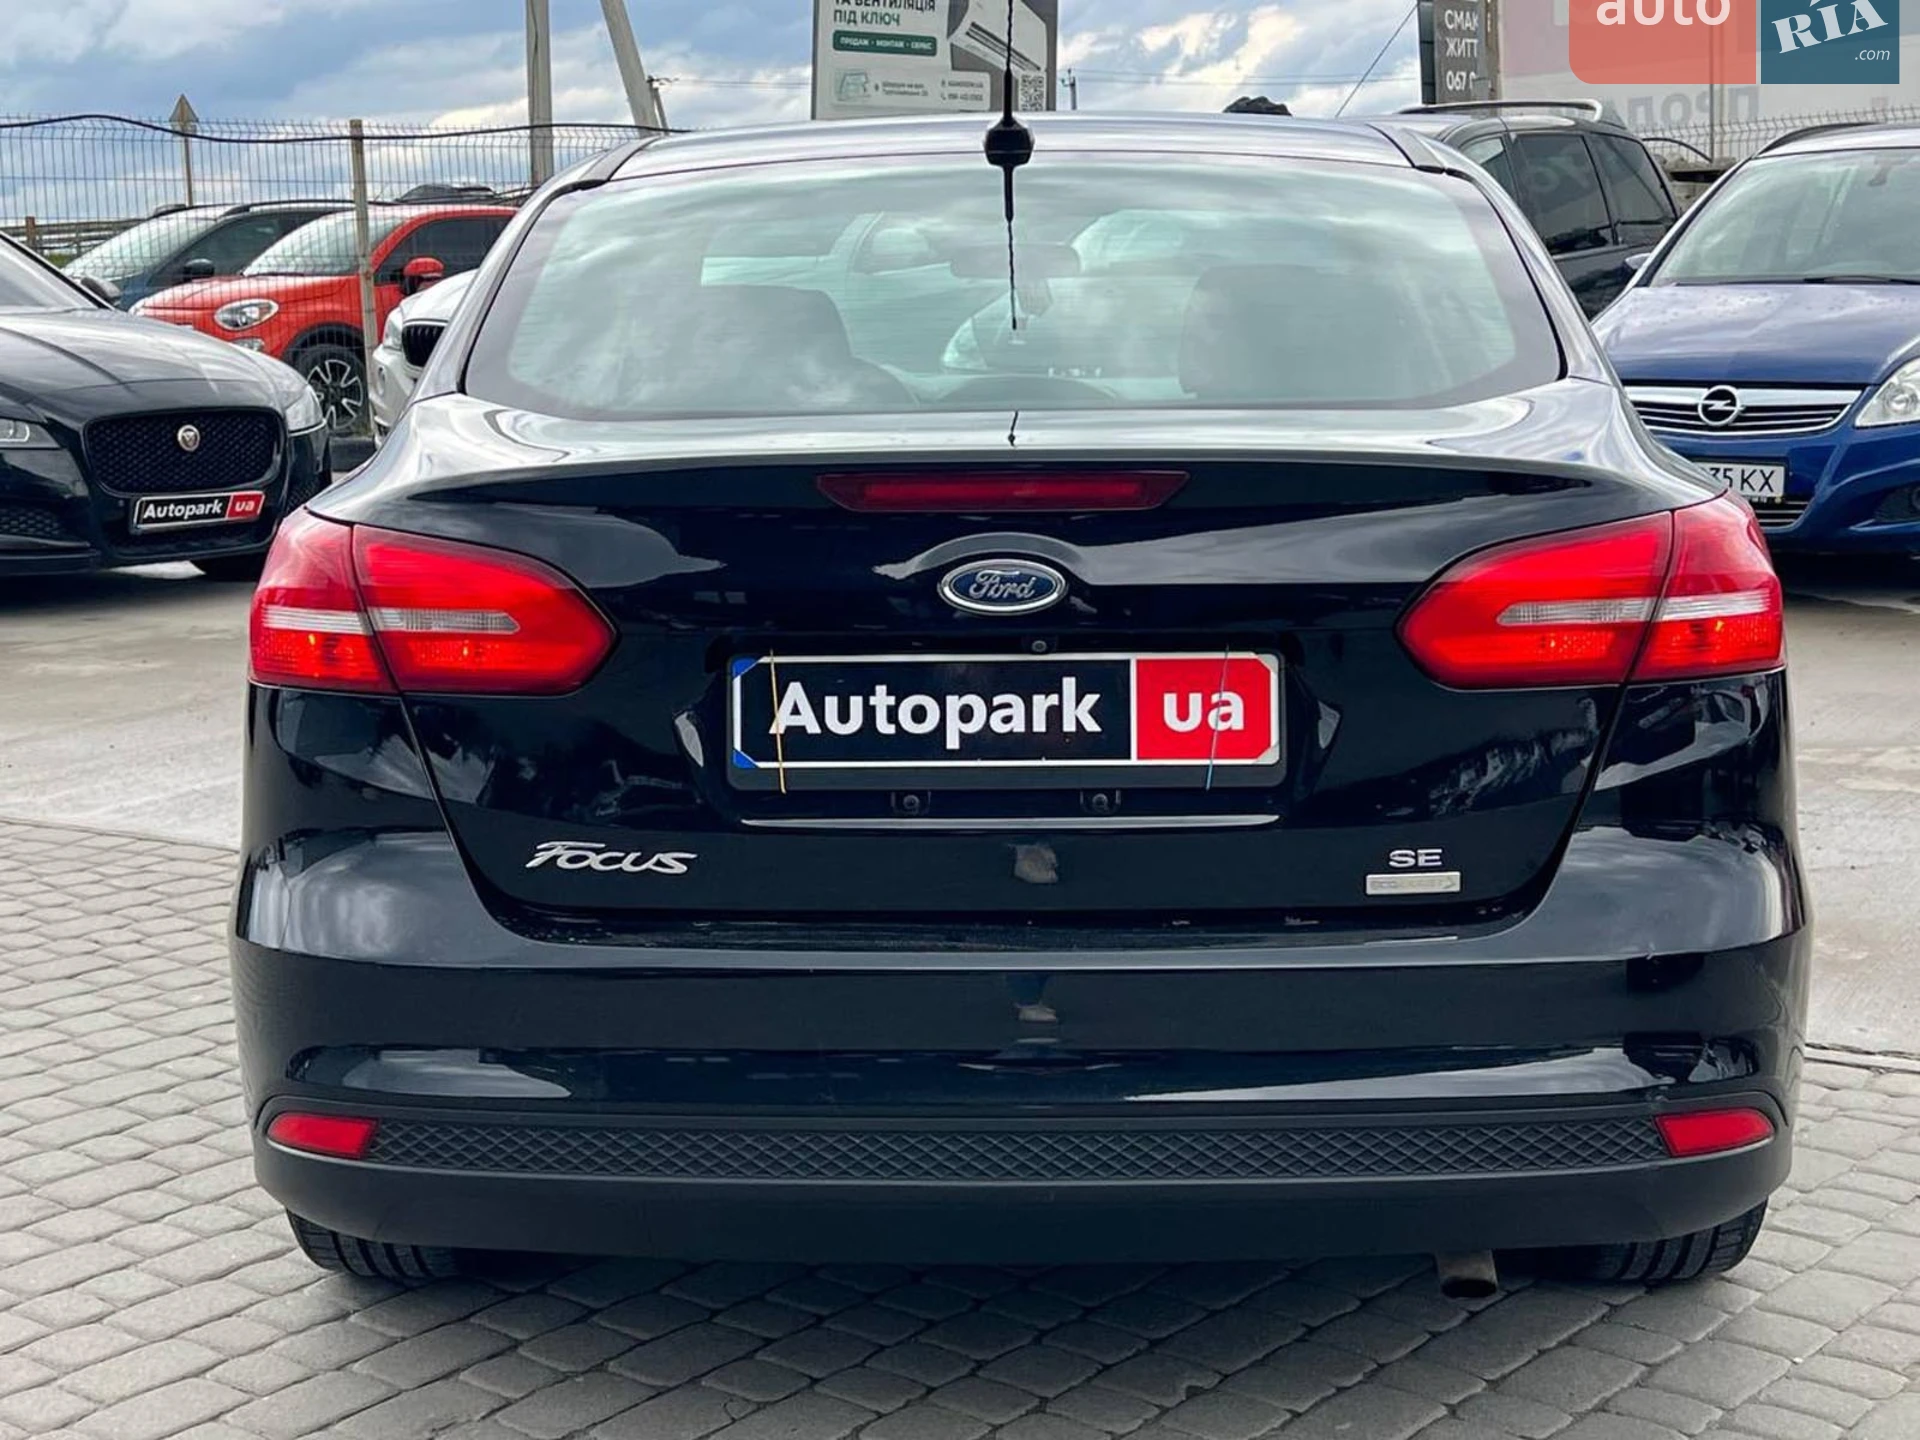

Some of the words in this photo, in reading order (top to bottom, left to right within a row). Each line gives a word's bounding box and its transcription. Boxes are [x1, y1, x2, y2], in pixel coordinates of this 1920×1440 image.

[833, 9, 857, 25] ПІД
[860, 11, 901, 26] КЛЮЧ
[1445, 37, 1479, 58] ЖИТТ
[1445, 70, 1467, 91] 067
[1740, 468, 1775, 493] KX
[143, 499, 223, 520] Autopark
[235, 500, 255, 512] ua
[969, 569, 1036, 599] Ford
[769, 677, 1102, 750] Autopark
[1162, 690, 1245, 733] ua
[1388, 848, 1443, 868] SE
